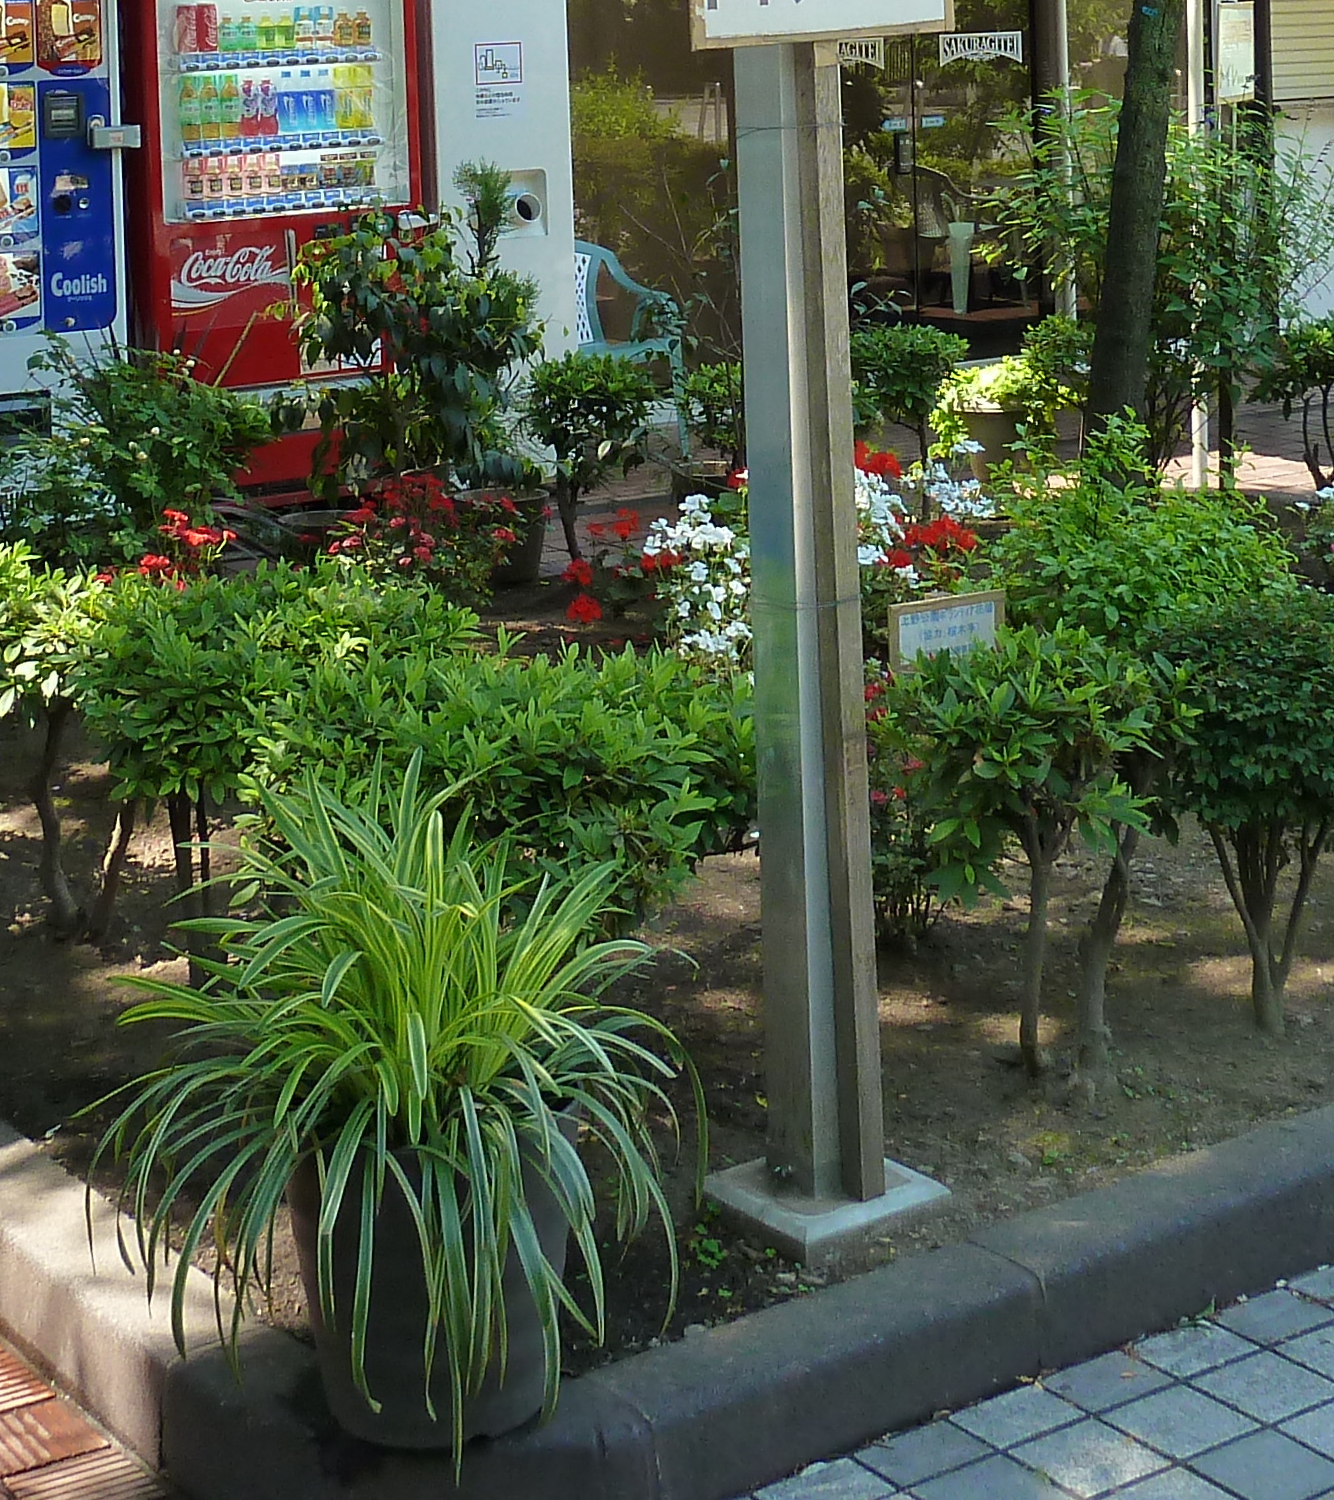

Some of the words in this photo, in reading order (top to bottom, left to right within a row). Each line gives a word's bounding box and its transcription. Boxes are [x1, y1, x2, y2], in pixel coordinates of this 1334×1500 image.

[838, 41, 879, 60] AGITEI
[943, 36, 1018, 58] SAKURAGITEI
[181, 244, 276, 287] Coca-Cola
[50, 272, 107, 297] Coolish
